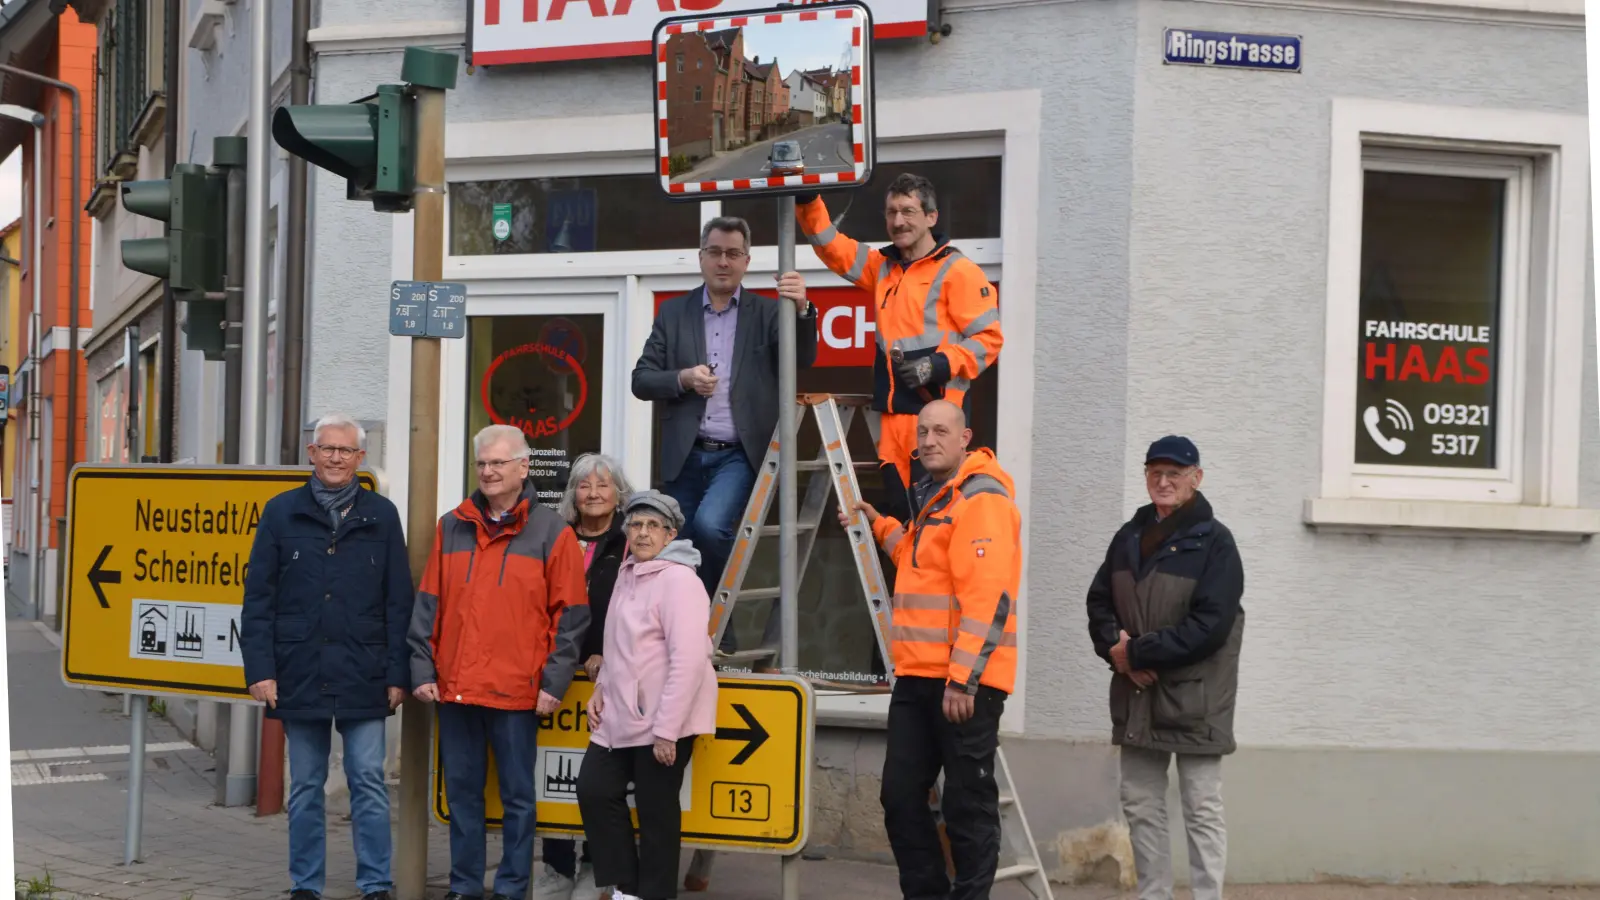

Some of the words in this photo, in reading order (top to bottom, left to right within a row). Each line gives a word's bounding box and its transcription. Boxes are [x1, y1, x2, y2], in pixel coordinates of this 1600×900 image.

[1170, 30, 1296, 65] Ringstrasse
[392, 288, 401, 300] S
[411, 293, 426, 301] 200
[429, 290, 438, 302] S
[449, 295, 465, 303] 200
[1365, 320, 1490, 343] FAHRSCHULE
[503, 342, 566, 360] FAHRSCHULE
[1364, 342, 1490, 385] HAAS
[1423, 403, 1489, 426] 09321
[1431, 434, 1480, 456] 5317
[729, 789, 752, 813] 13
